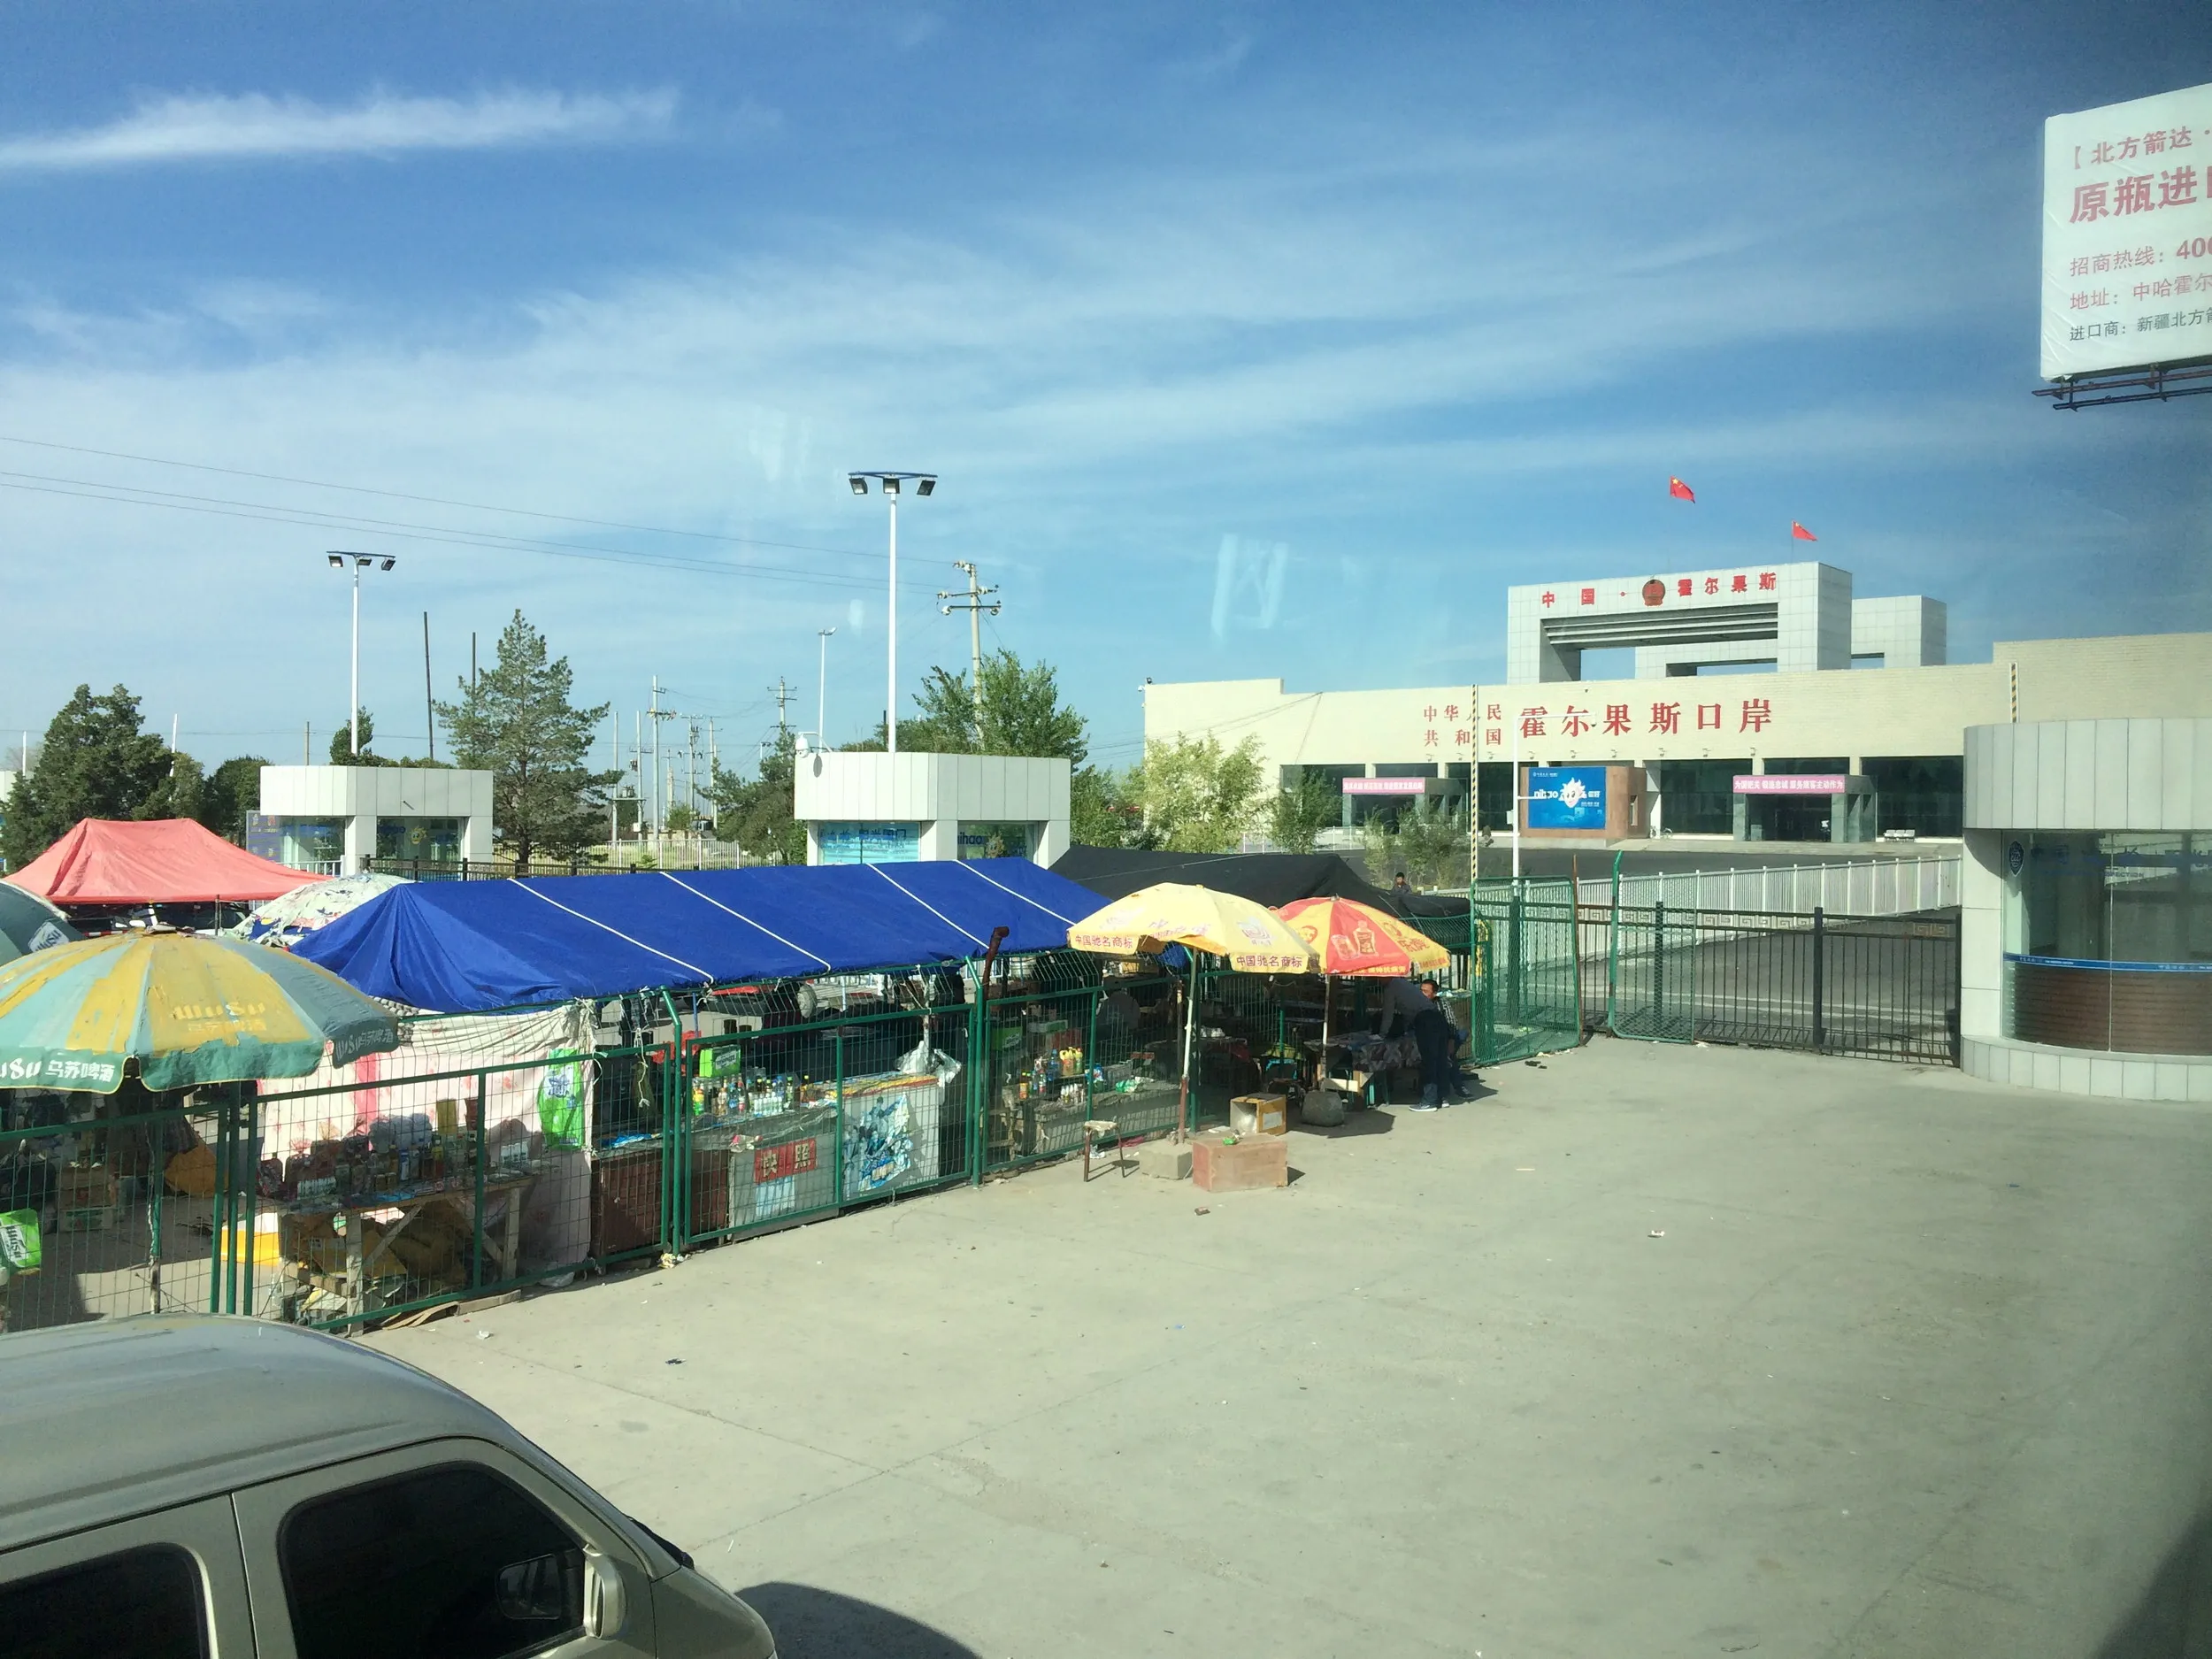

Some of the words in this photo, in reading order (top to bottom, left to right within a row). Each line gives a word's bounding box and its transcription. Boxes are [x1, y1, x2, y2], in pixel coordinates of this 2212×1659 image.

[2070, 165, 2212, 224] 原瓶进
[1678, 572, 1776, 597] 霍尔果斯
[1519, 698, 1771, 739] 霍尔果斯口岸
[1425, 728, 1502, 747] 共和国
[1236, 955, 1302, 968] 中国驰名商标
[45, 1060, 115, 1082] 乌苏啤酒
